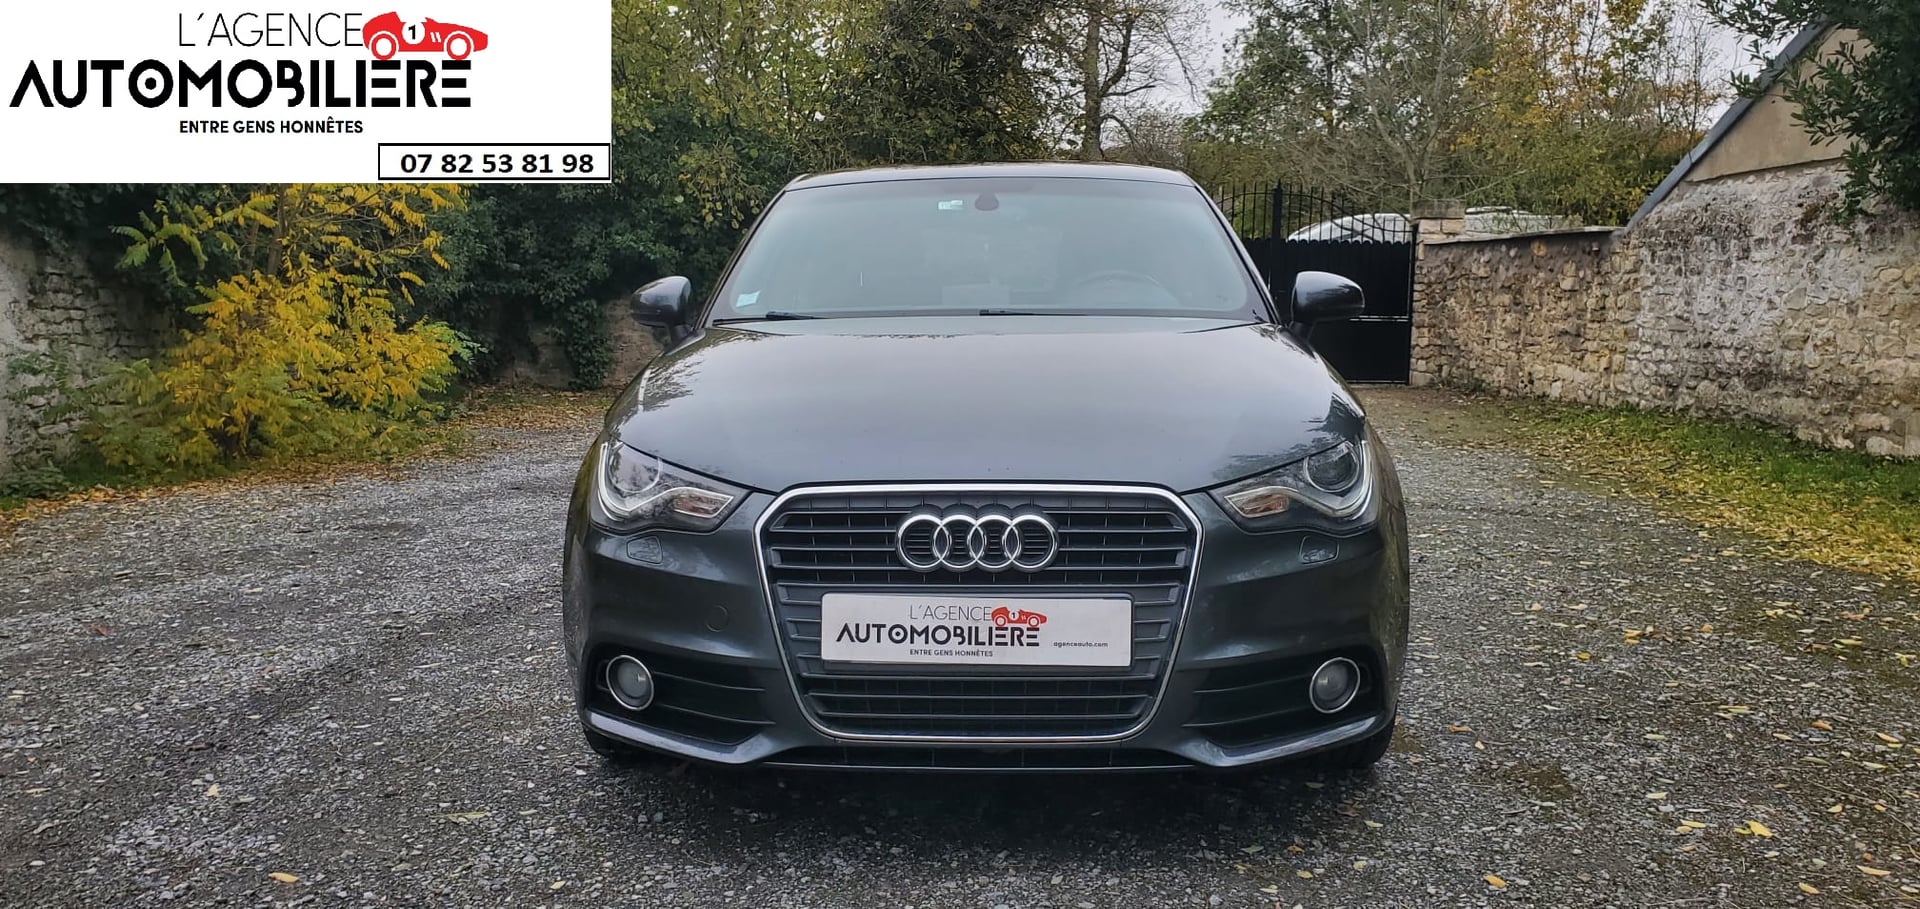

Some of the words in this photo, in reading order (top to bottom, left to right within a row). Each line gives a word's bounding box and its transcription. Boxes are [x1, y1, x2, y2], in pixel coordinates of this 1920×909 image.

[909, 604, 993, 622] L'AGENCE
[1053, 641, 1109, 649] agenceauto.com
[909, 648, 932, 656] ENTRE
[933, 649, 953, 657] GENS
[954, 648, 993, 657] HONNÊTES
